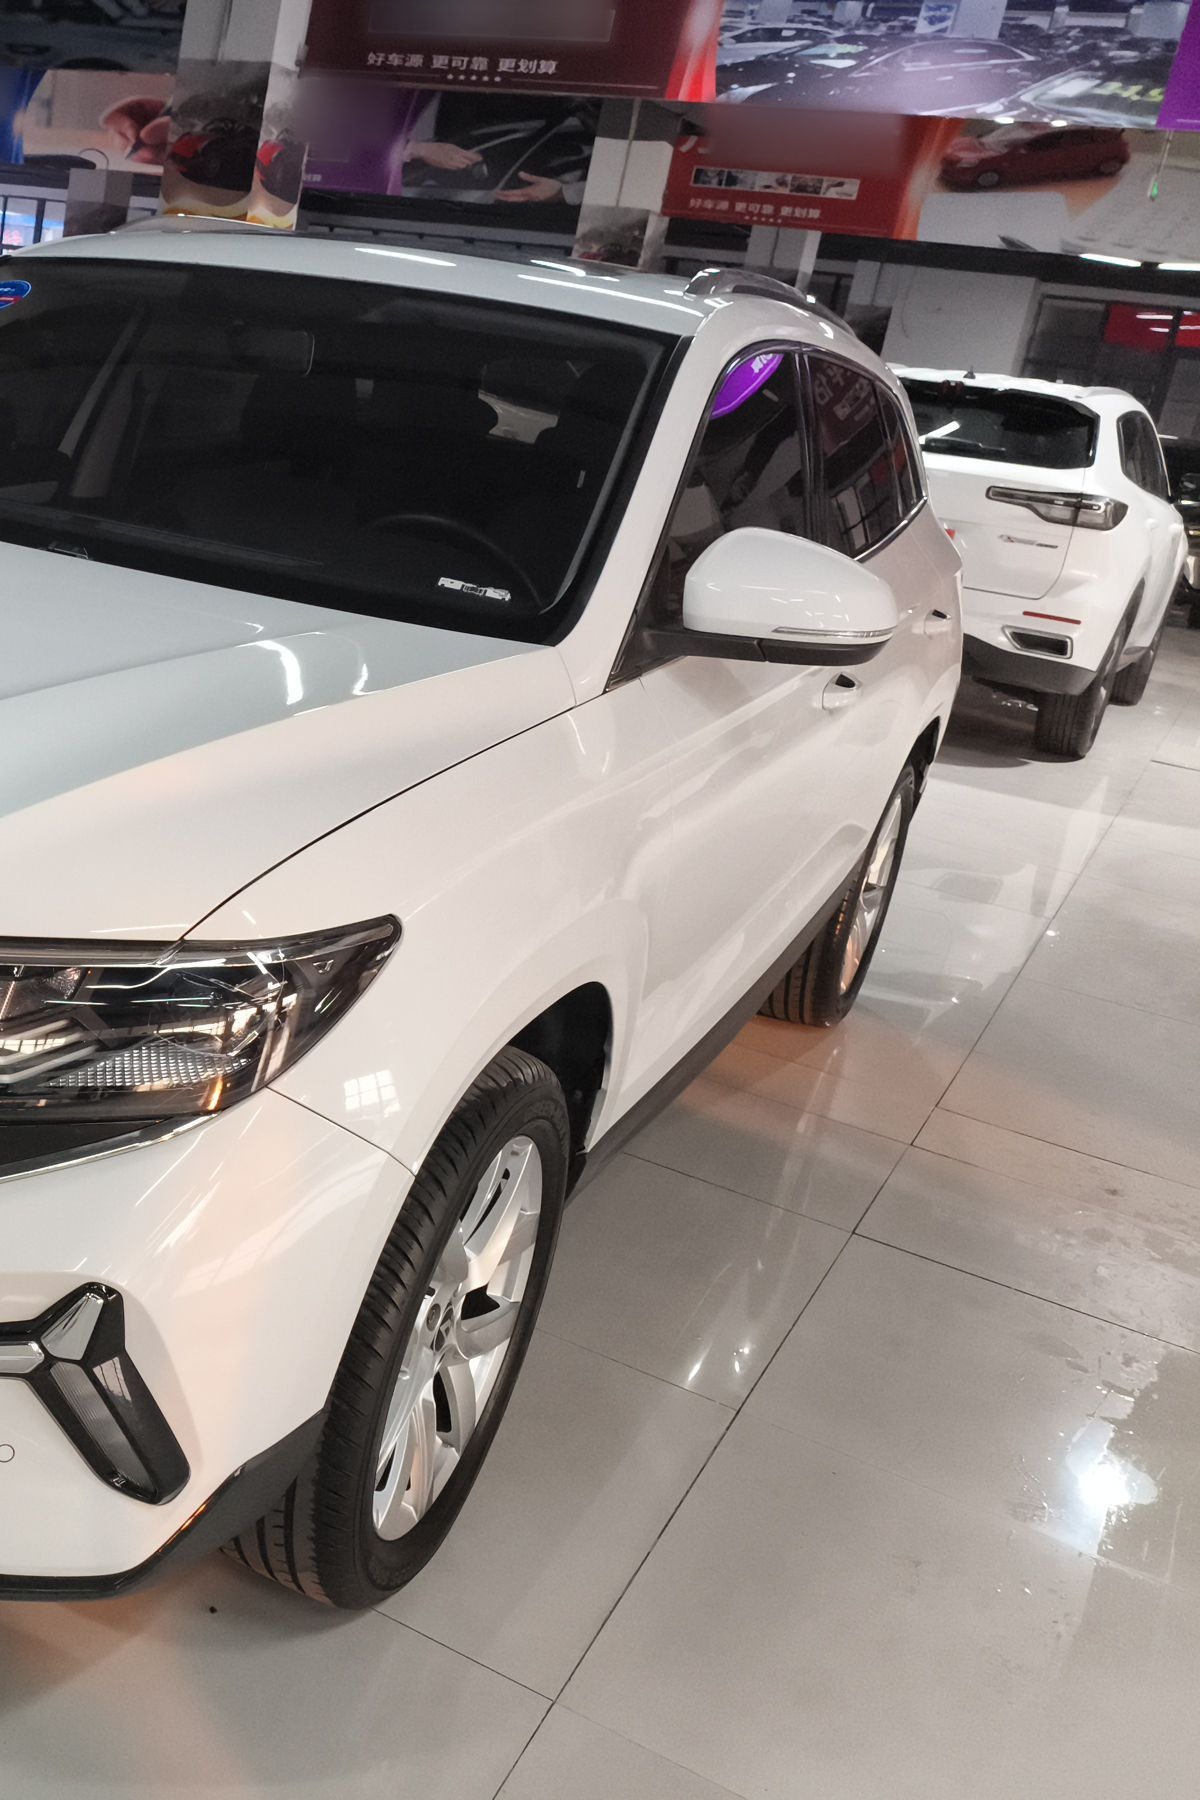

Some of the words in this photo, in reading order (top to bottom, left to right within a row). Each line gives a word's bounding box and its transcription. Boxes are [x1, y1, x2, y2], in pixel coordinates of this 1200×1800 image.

[367, 52, 424, 68] 好车源
[431, 54, 489, 72] 更可靠
[497, 57, 559, 75] 更划算
